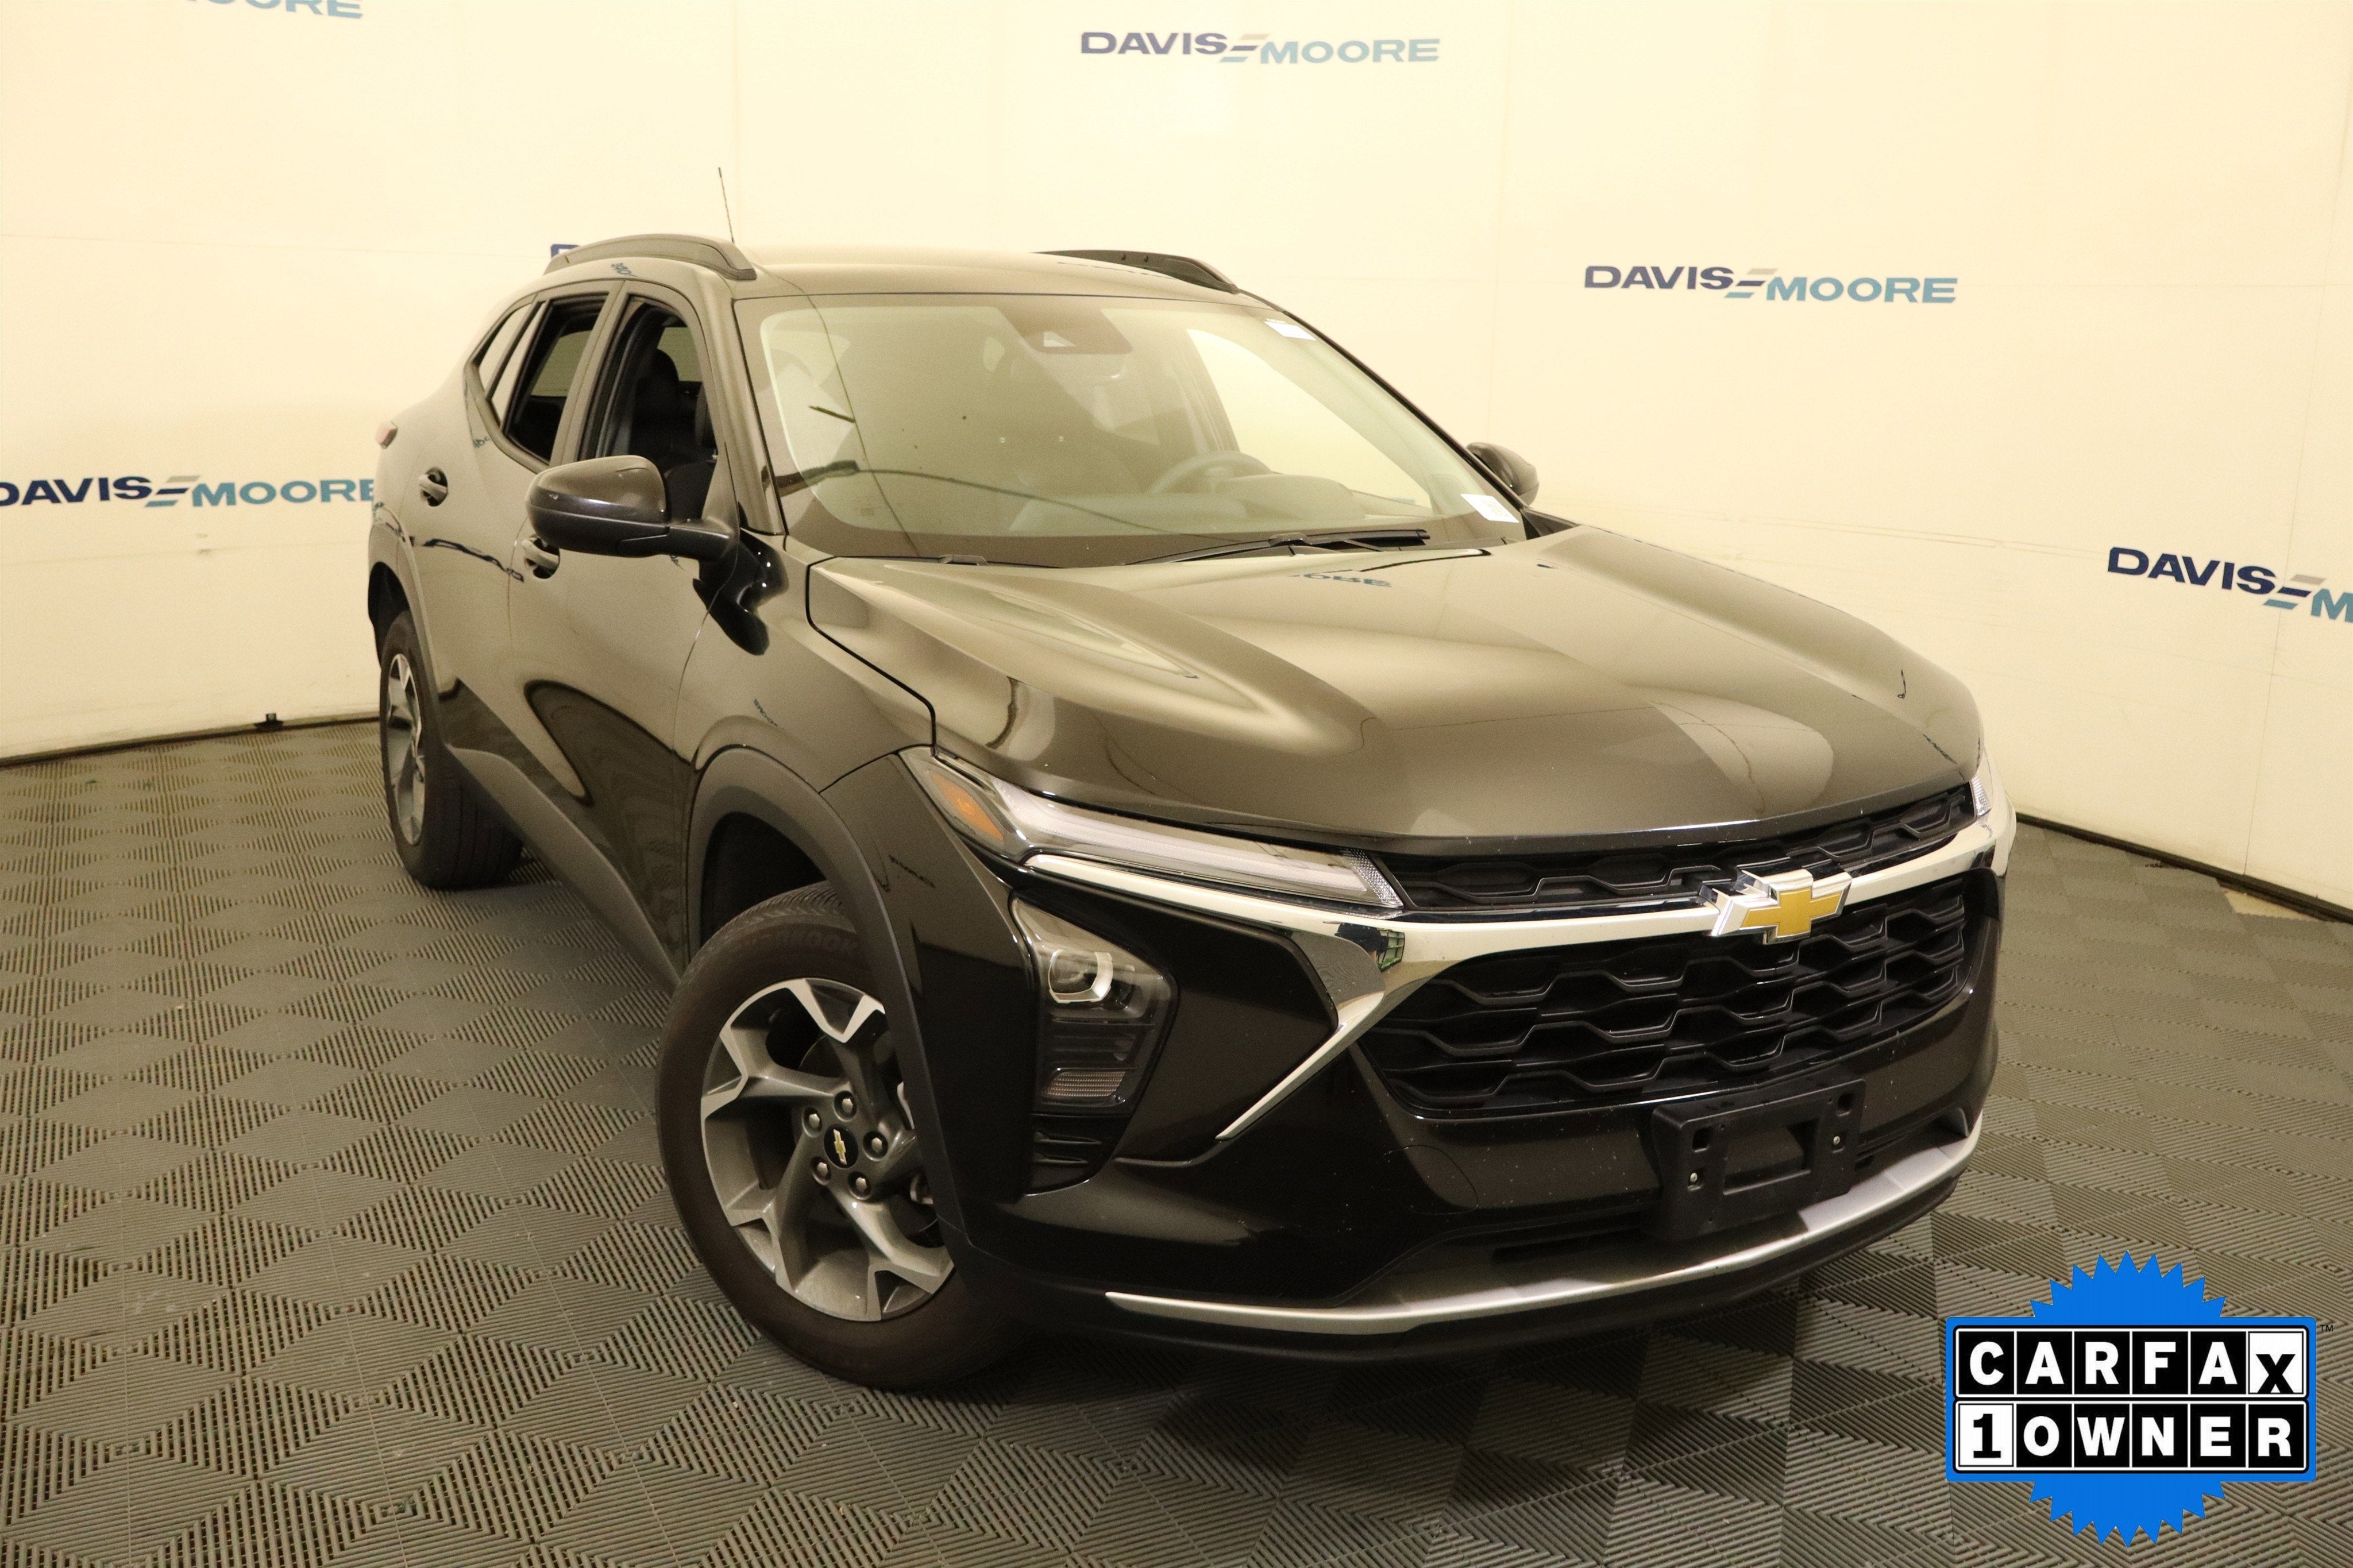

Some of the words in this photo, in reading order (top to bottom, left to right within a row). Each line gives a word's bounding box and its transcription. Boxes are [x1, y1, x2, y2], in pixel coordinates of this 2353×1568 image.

[1081, 32, 1228, 55] DAVIS
[1260, 38, 1441, 64] MOORE
[1584, 265, 1734, 289] DAVIS
[1766, 277, 1958, 303] MOORE
[2108, 546, 2277, 594] DAVIS
